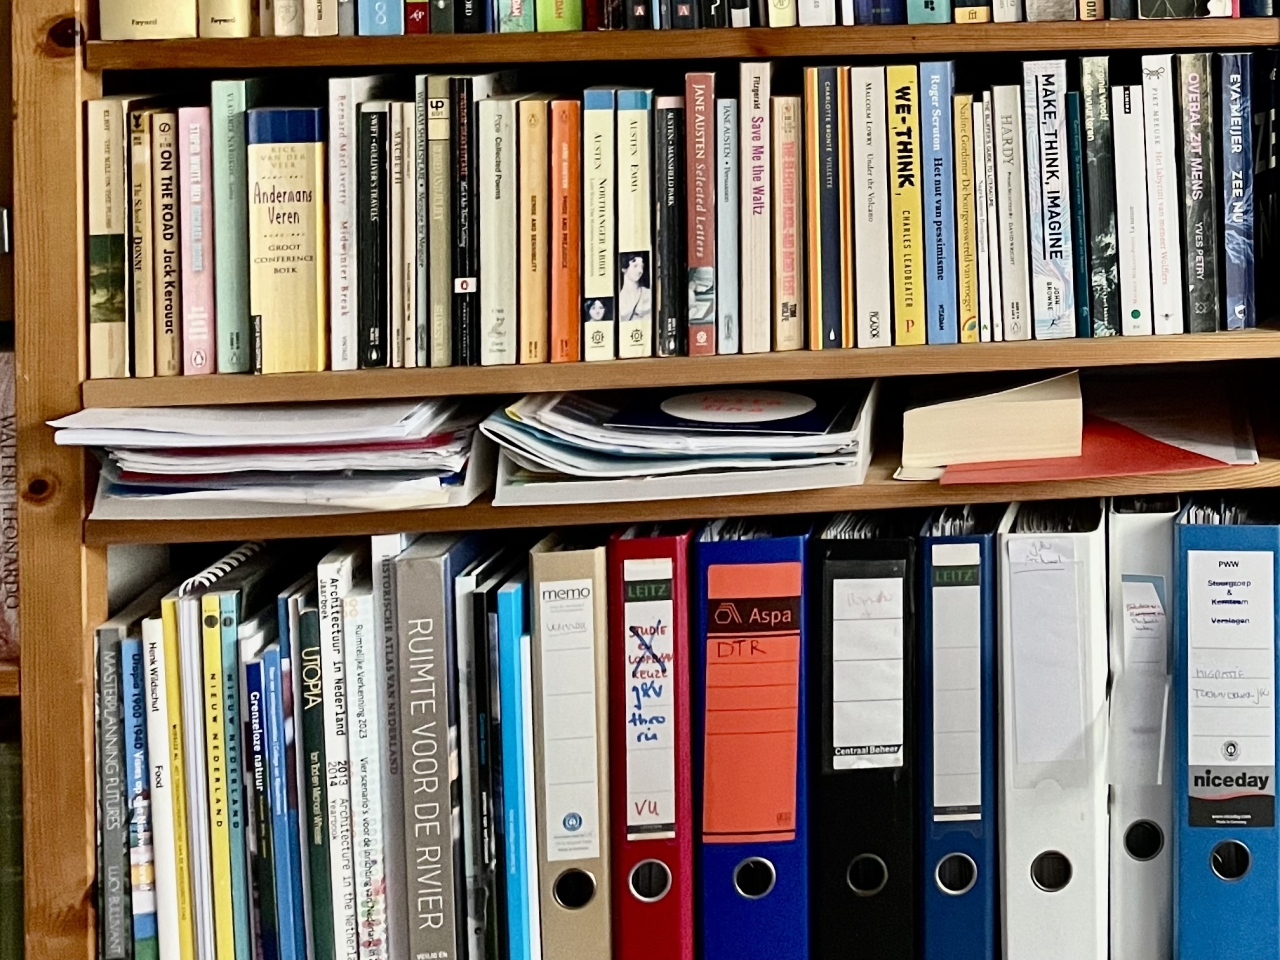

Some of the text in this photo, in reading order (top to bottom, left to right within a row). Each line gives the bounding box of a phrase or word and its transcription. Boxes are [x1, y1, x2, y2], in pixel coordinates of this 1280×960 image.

[928, 75, 946, 281] Roger Scruton Het nut van pessimisme
[1040, 74, 1062, 260] MAKE, THINK, IMAGINE
[1187, 73, 1205, 280] OVERAL ZIT MENS YVES PETRY
[253, 182, 312, 204] Andermans
[695, 163, 707, 213] Selected
[268, 207, 300, 224] Veren
[902, 210, 911, 249] CHARLES
[161, 150, 176, 334] ON THE ROAD Jack Kerouac
[695, 216, 707, 257] Letters
[903, 254, 913, 308] LEADBEATER
[542, 586, 591, 600] memo
[628, 584, 667, 598] LEITZ
[749, 608, 792, 626] Aspa
[717, 639, 767, 658] DTR
[302, 647, 320, 709] UTOPIA
[148, 642, 164, 788] Henk Wildschut Food
[835, 745, 899, 755] Centraal Beheer
[407, 618, 444, 929] RUIMTE VOOR DE RIVIER
[1194, 770, 1270, 790] niceday
